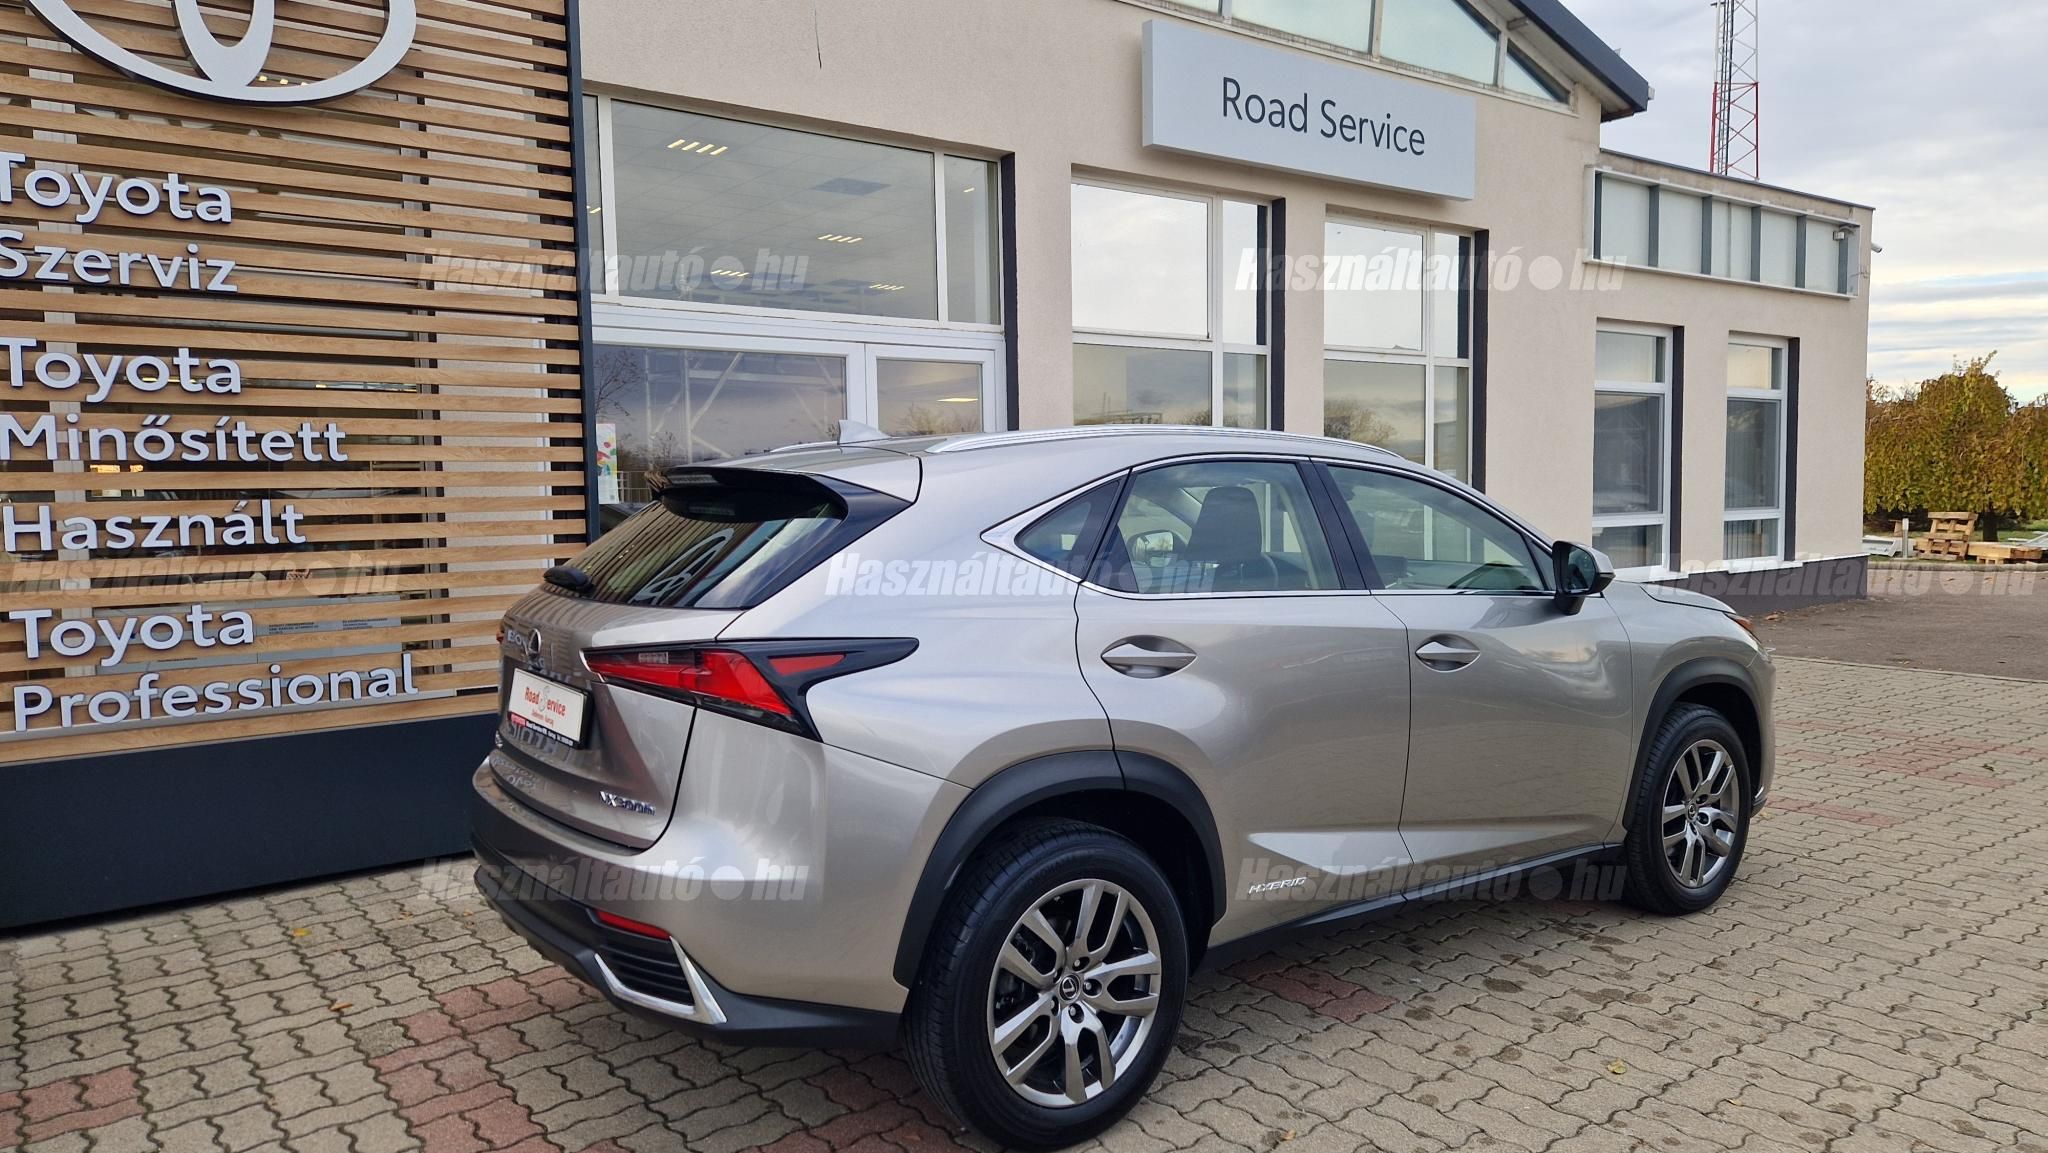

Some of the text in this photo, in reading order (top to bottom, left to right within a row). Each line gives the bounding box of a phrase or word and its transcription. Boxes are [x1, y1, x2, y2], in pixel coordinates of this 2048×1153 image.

[1222, 76, 1426, 156] Road Service
[0, 152, 232, 223] Toyota
[0, 229, 238, 292] Szerviz
[0, 336, 242, 403] Toyota
[0, 413, 349, 462] Minősített
[2, 499, 307, 552] Használt
[8, 604, 255, 668] Toyota
[13, 653, 419, 732] Professional
